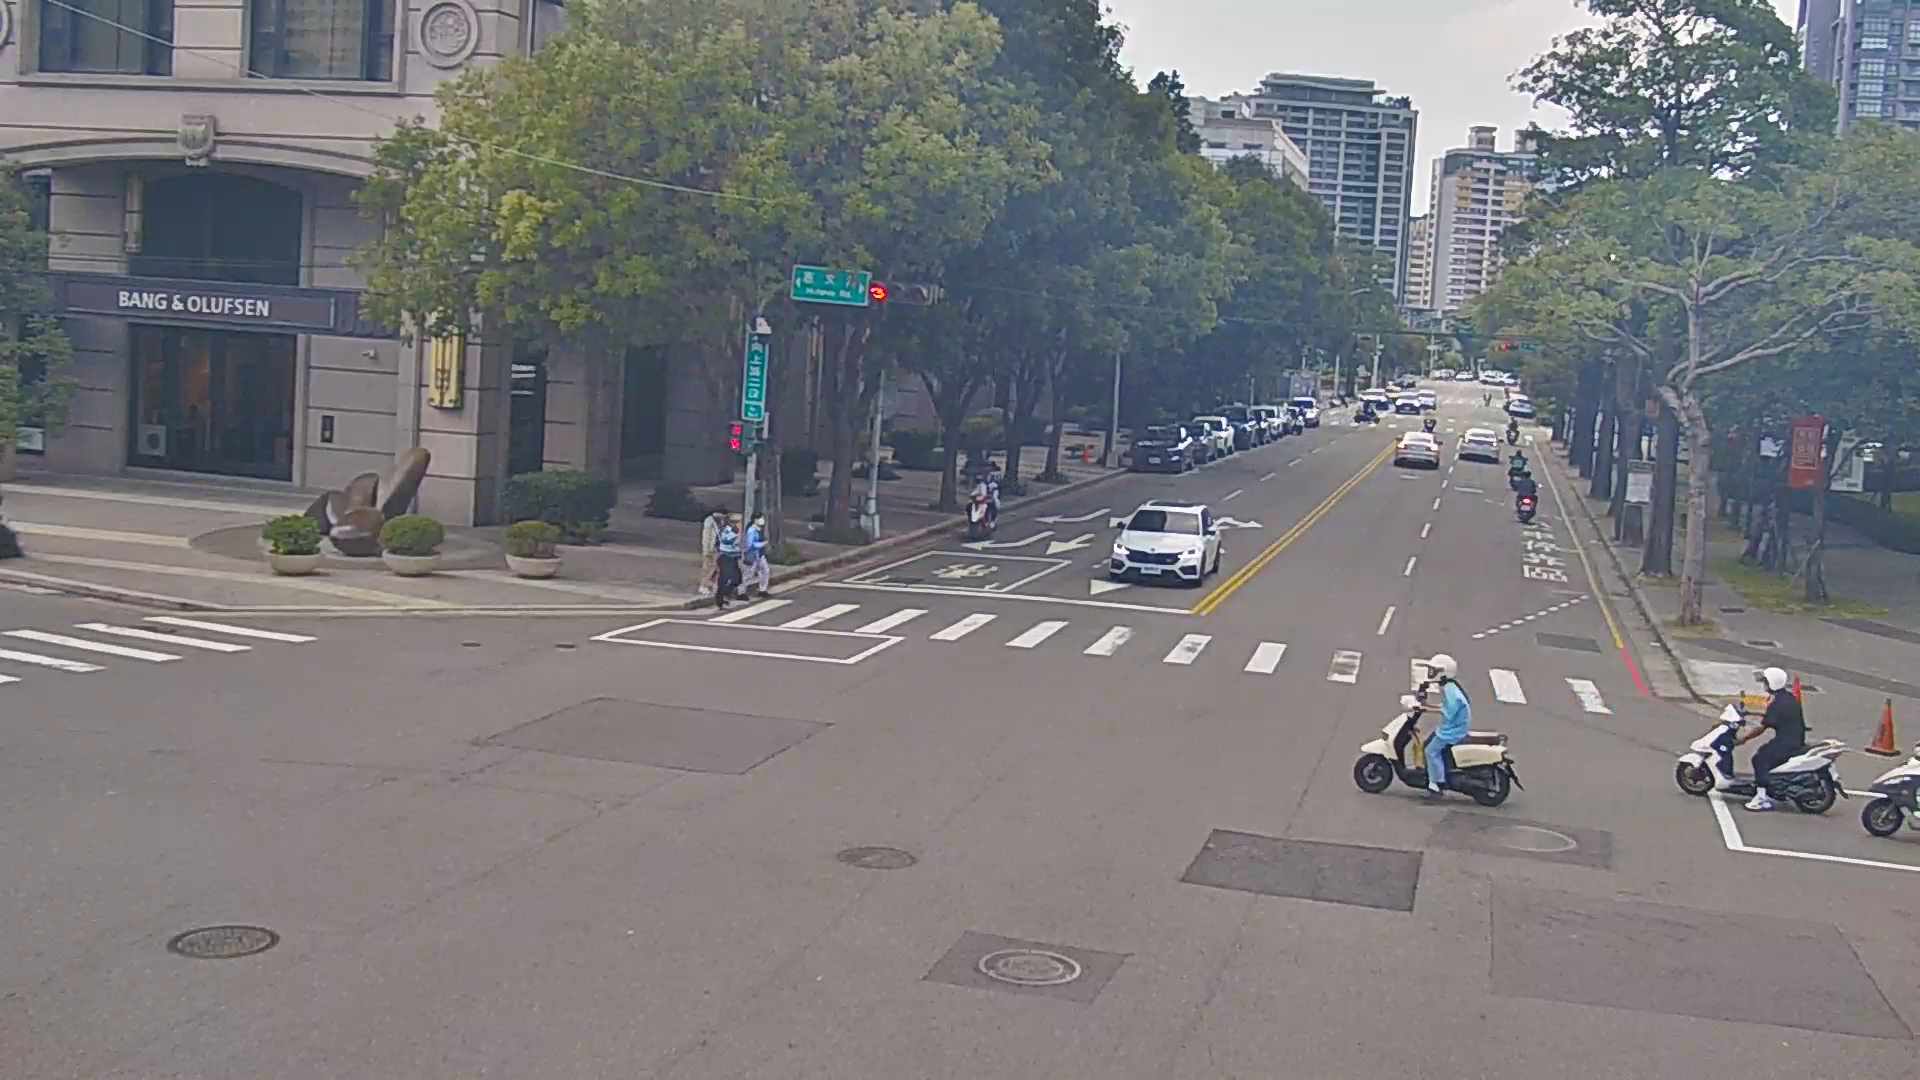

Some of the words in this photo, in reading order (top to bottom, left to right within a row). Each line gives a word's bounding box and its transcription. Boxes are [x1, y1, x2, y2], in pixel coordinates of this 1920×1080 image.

[118, 291, 168, 310] BANG
[171, 294, 185, 311] &
[187, 295, 270, 317] OLUFSEN
